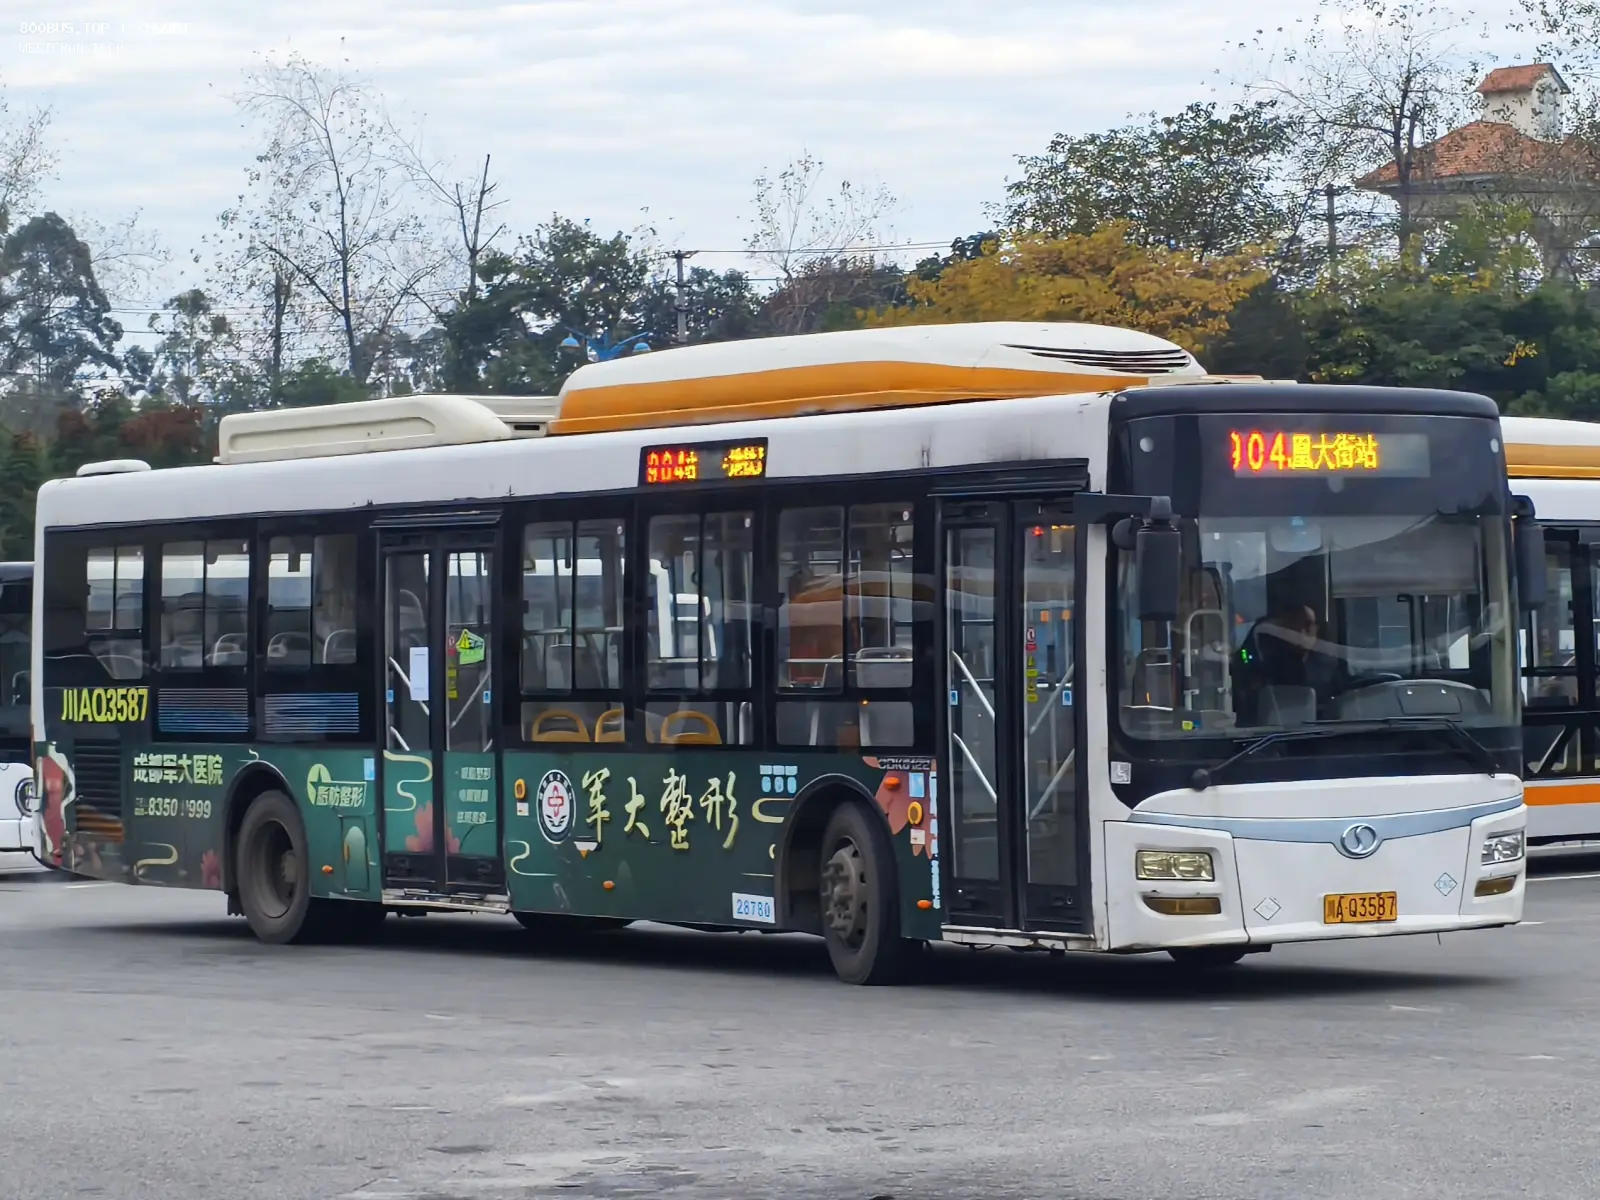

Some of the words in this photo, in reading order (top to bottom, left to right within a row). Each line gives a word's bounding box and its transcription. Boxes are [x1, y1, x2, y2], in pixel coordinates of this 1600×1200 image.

[61, 687, 149, 722] 川AQ3587
[581, 767, 740, 850] 军大整形
[736, 898, 771, 918] 28780
